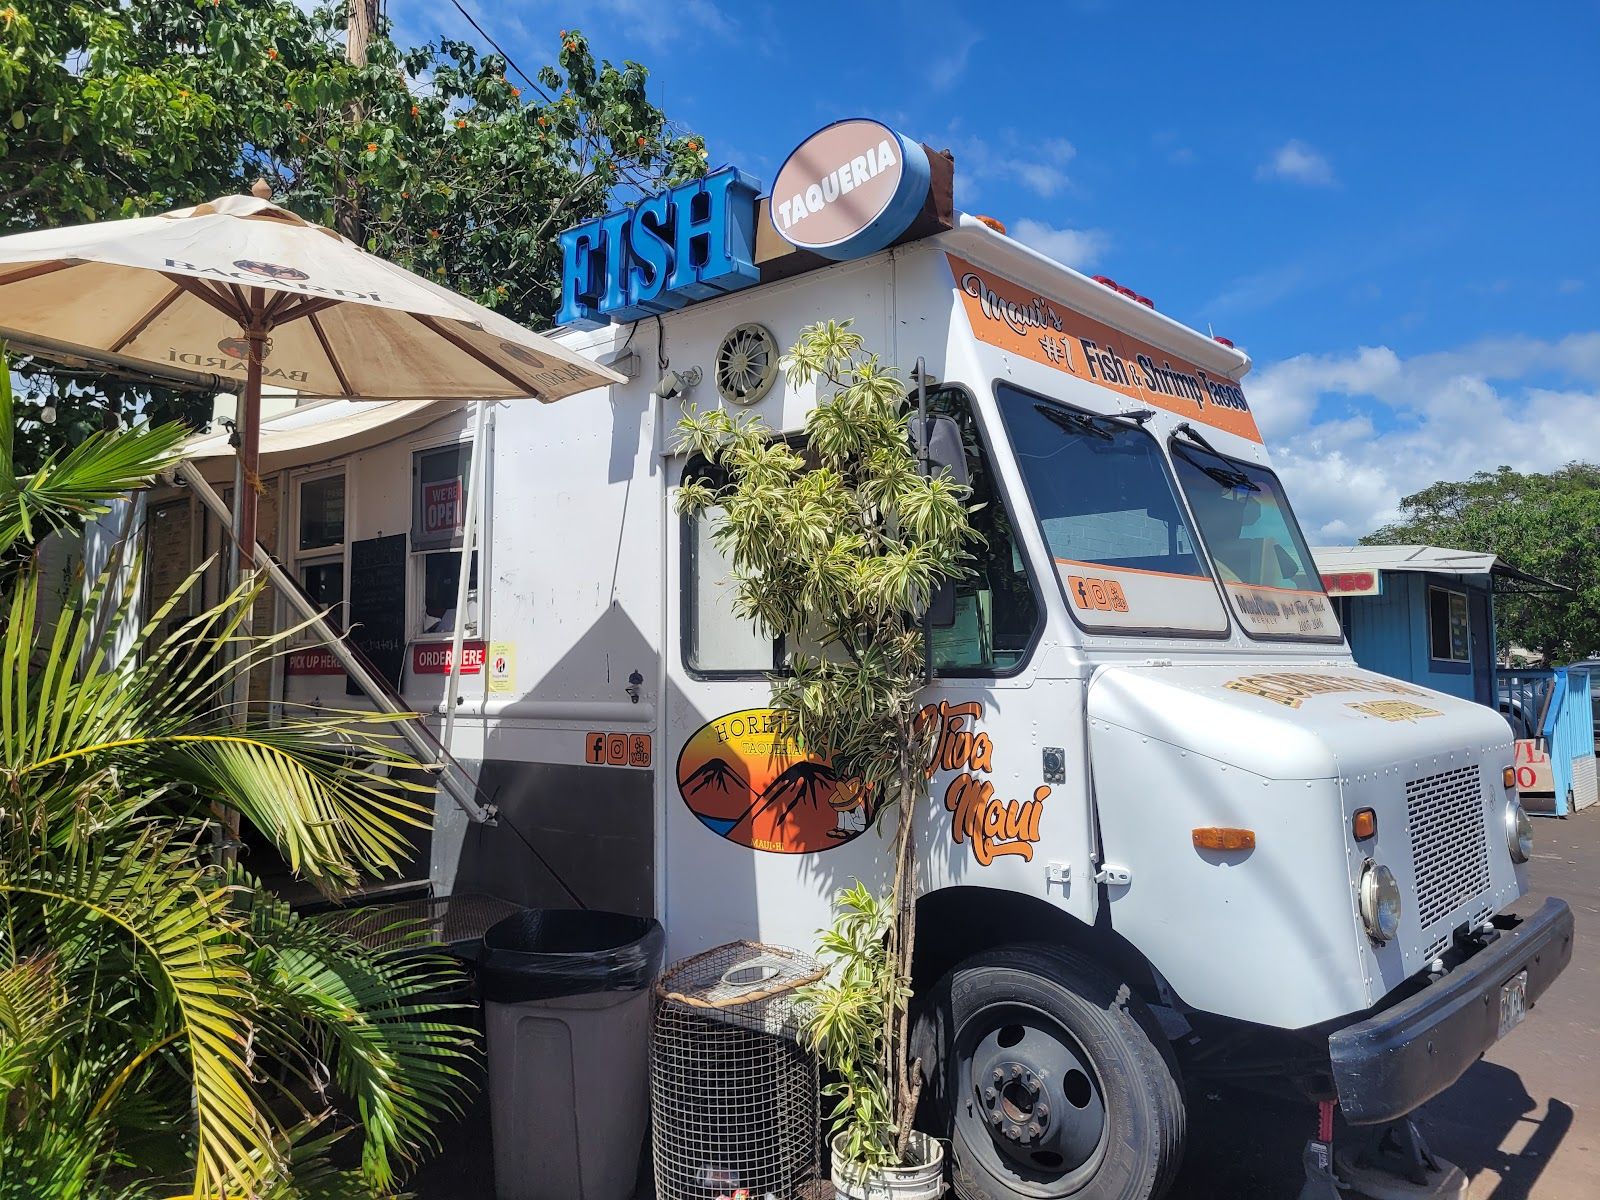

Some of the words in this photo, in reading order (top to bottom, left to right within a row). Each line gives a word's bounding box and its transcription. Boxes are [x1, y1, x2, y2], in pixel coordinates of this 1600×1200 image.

[778, 140, 897, 230] TAQUERIA
[555, 165, 737, 327] FISH
[961, 272, 1063, 337] Maui's
[1038, 335, 1075, 372] #1
[1079, 338, 1131, 387] Fish
[1128, 363, 1143, 387] &
[1136, 354, 1204, 411] Shrimp
[1197, 370, 1249, 413] Tacos
[428, 500, 461, 528] OPEN
[432, 487, 457, 502] WE'RE
[1250, 616, 1278, 625] WEEKLY
[289, 656, 306, 669] PICK
[306, 655, 320, 668] UP
[419, 650, 453, 667] ORDER
[458, 649, 483, 665] ERE
[913, 700, 993, 780] Viva
[944, 773, 1052, 867] Maui
